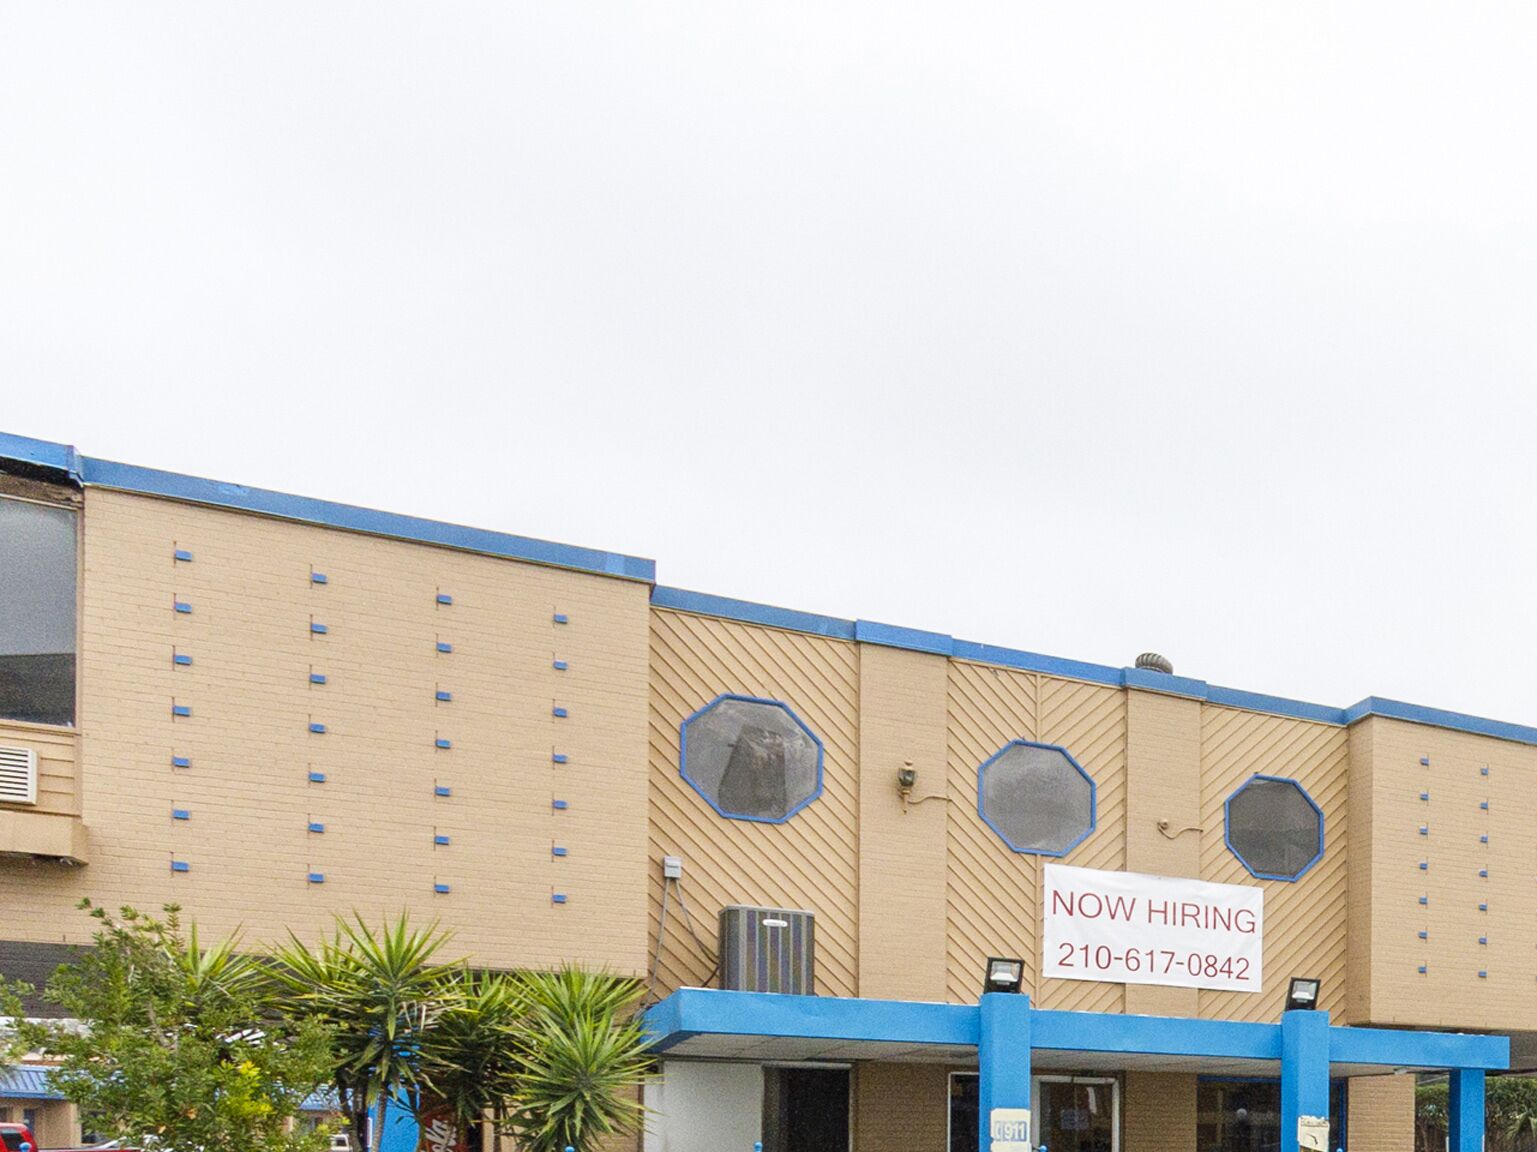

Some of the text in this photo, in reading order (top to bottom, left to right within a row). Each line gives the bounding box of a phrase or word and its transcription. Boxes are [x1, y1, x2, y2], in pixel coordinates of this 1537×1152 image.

[1052, 890, 1256, 934] NOW HIRING
[1058, 942, 1250, 980] 210-617-0842
